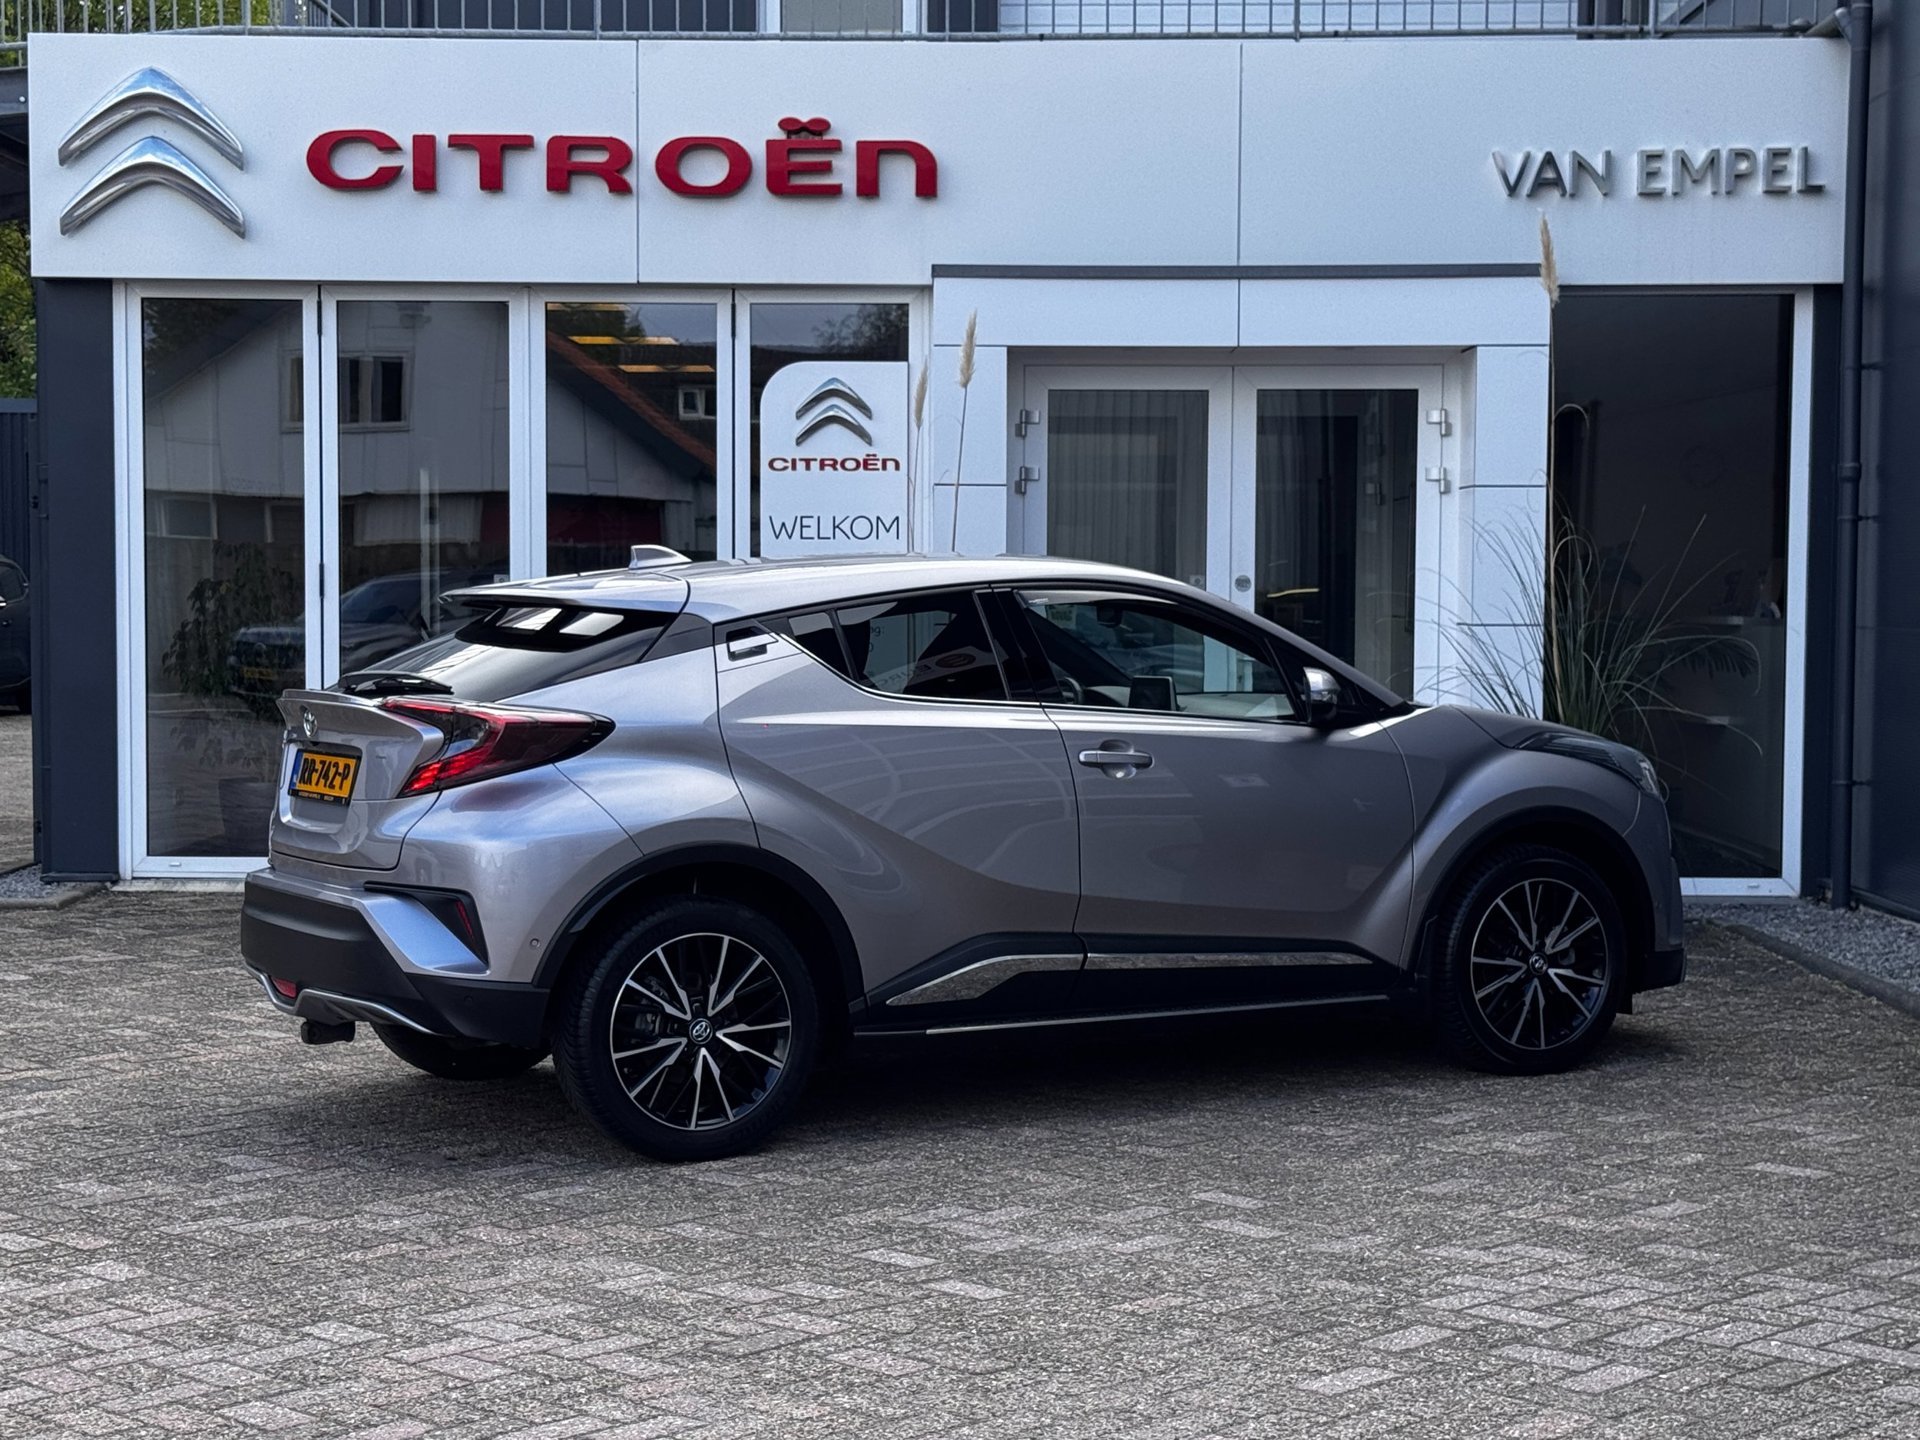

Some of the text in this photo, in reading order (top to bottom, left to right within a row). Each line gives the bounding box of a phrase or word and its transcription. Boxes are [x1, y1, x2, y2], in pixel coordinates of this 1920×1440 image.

[306, 116, 938, 199] CITROËN
[1492, 146, 1826, 197] VAN EMPEL
[769, 515, 900, 541] WELKOM
